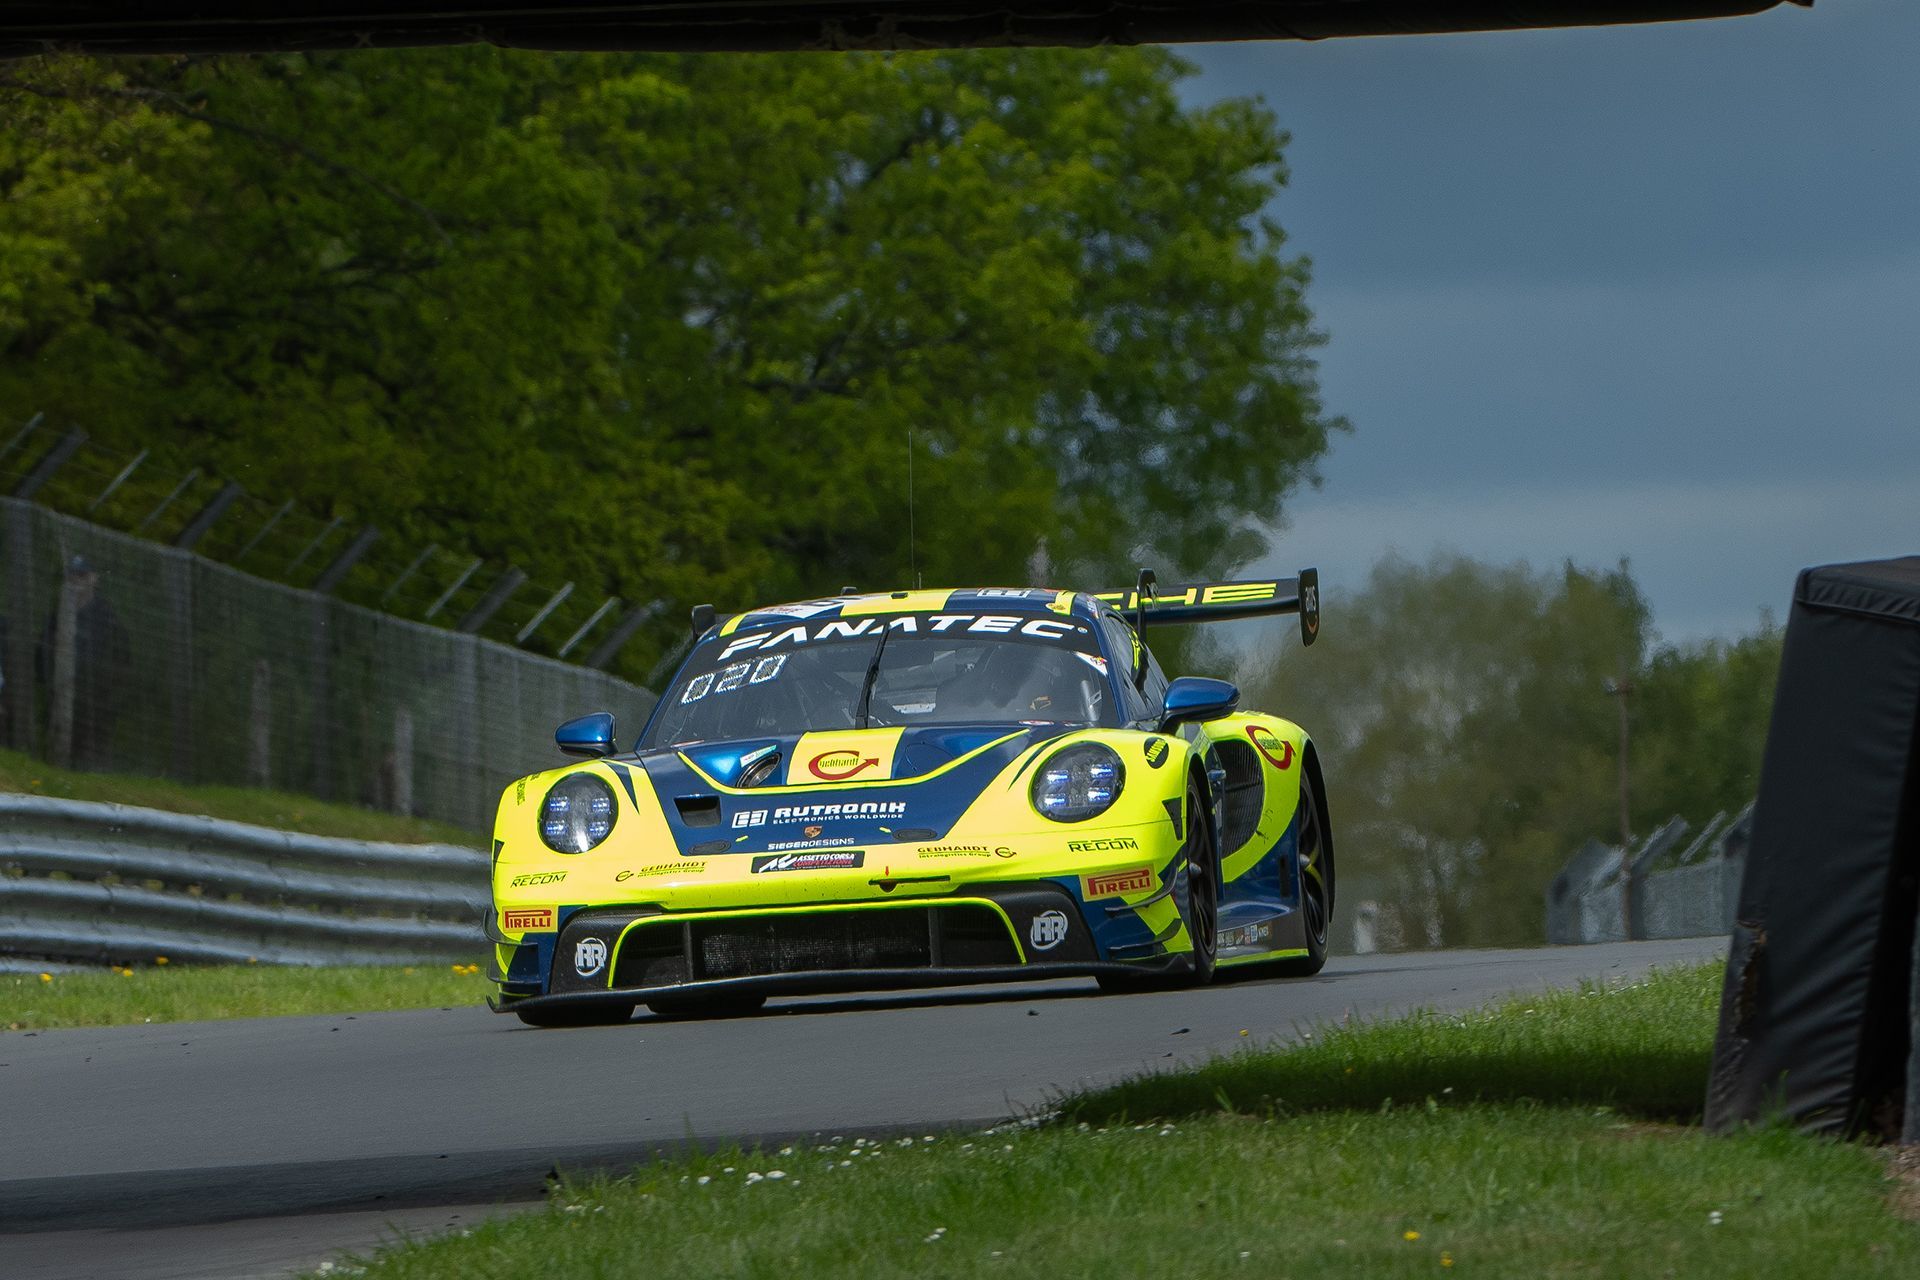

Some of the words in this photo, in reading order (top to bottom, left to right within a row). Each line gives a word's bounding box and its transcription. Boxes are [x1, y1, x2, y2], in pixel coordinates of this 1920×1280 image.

[717, 615, 1075, 662] FANATEC
[774, 801, 907, 818] RUTRONIK
[773, 814, 840, 824] ELECTRONICS
[844, 813, 904, 821] WORLDWIDE
[767, 838, 855, 851] SIEGERDESIGNS
[917, 845, 988, 853] GEBHARDT
[1069, 839, 1139, 853] RECOM
[797, 854, 830, 862] ASSETTO
[830, 853, 855, 861] CORSA
[641, 861, 708, 872] GEBHARDT
[510, 873, 567, 888] RECOM
[1087, 869, 1150, 896] PIRELLI
[504, 909, 552, 929] PIRELLI
